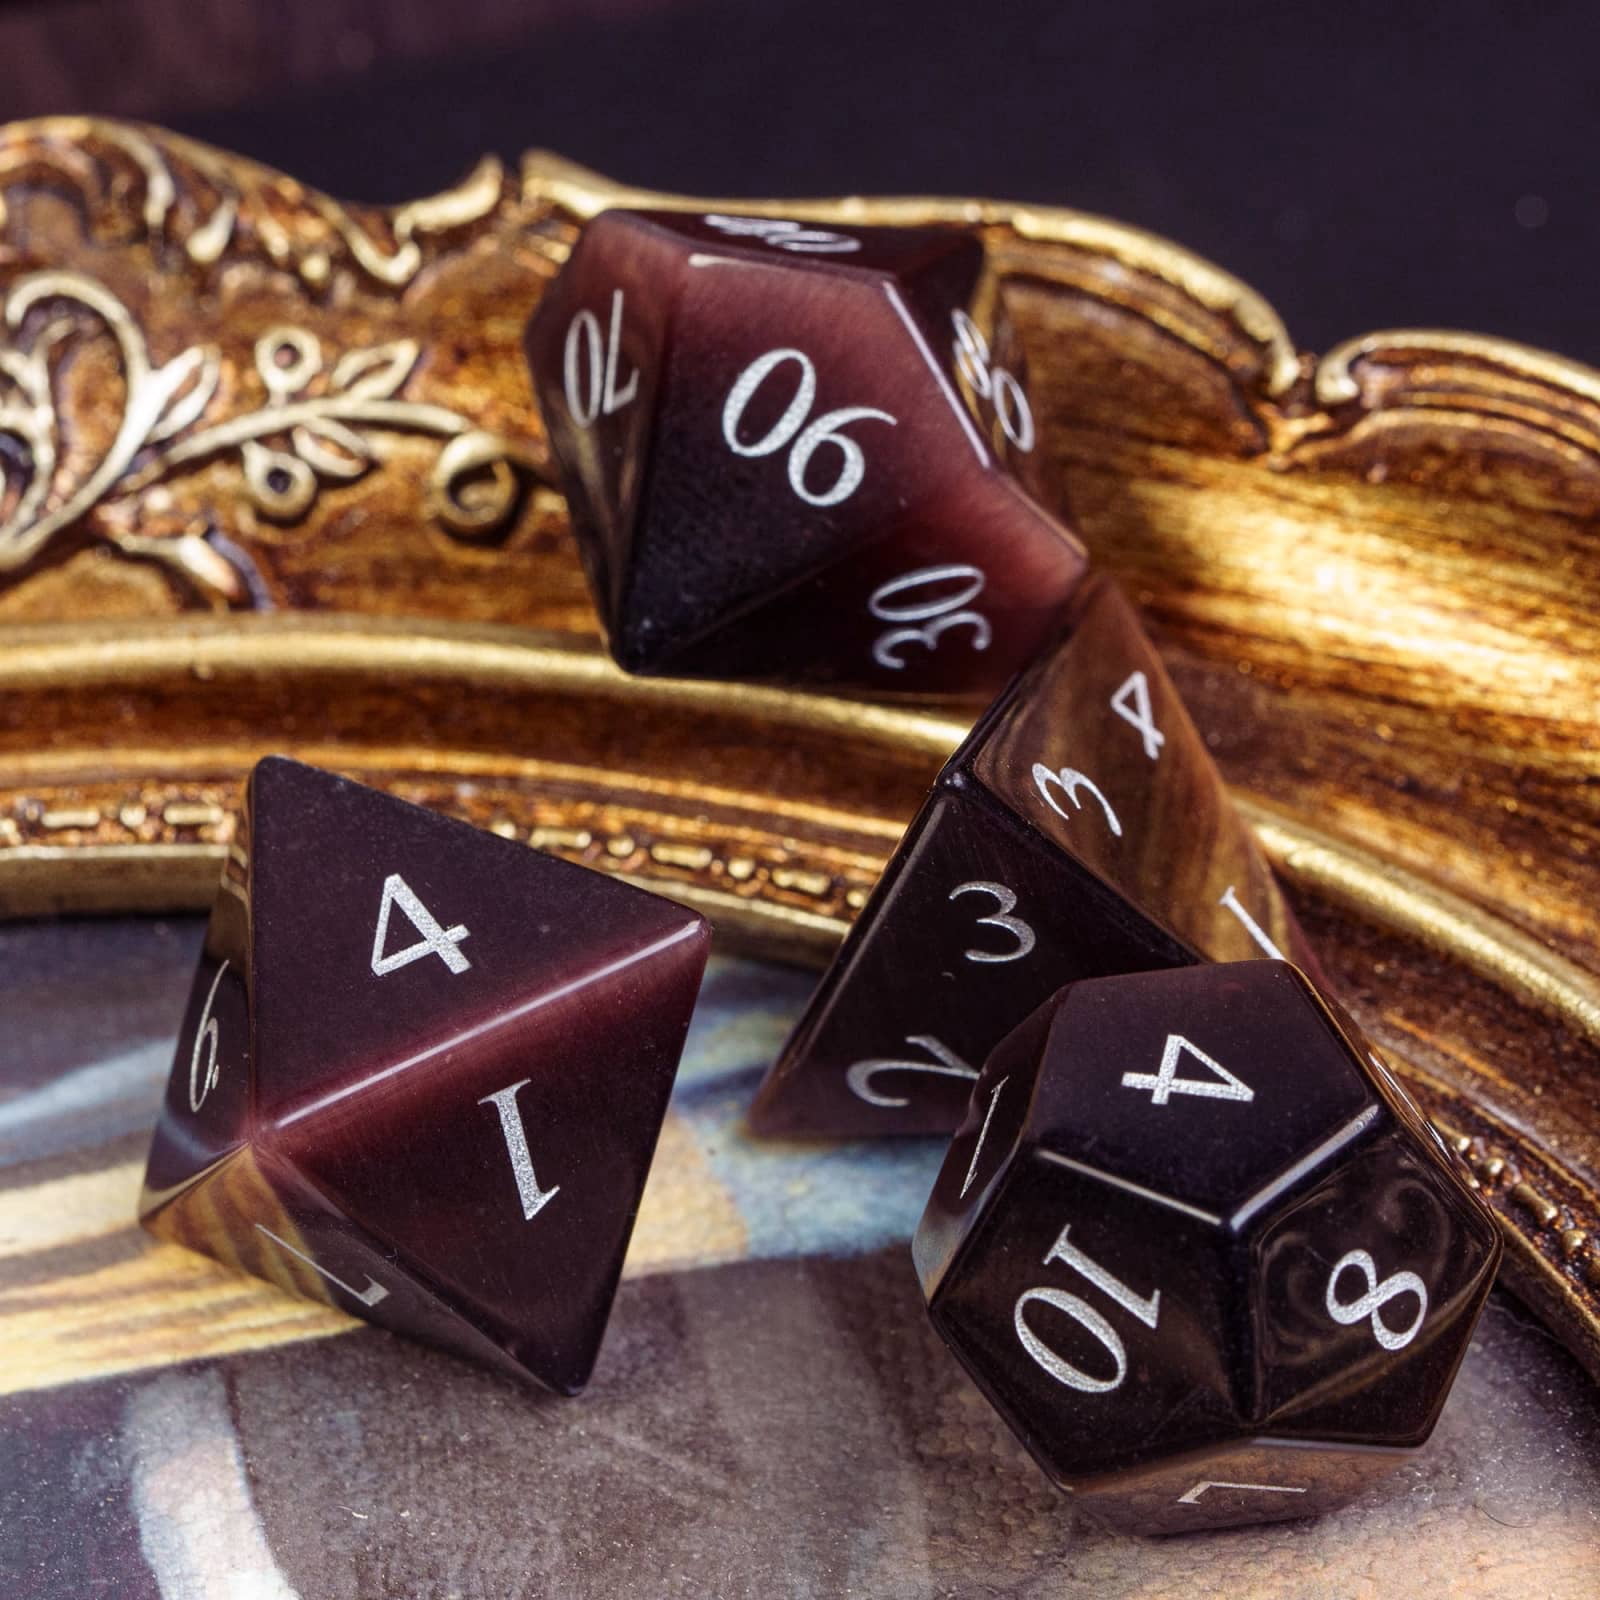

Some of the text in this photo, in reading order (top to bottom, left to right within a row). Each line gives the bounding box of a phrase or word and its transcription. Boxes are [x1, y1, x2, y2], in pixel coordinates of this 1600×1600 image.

[564, 288, 640, 427] 70
[868, 564, 992, 669] 30
[1110, 670, 1165, 760] 4
[1031, 762, 1122, 837] 3
[370, 873, 472, 976] 4
[948, 880, 1036, 962] 3
[846, 1035, 980, 1107] 2
[1121, 1034, 1254, 1105] 4
[477, 1078, 561, 1221] 1
[1014, 1223, 1161, 1393] 10
[1325, 1248, 1428, 1351] 8
